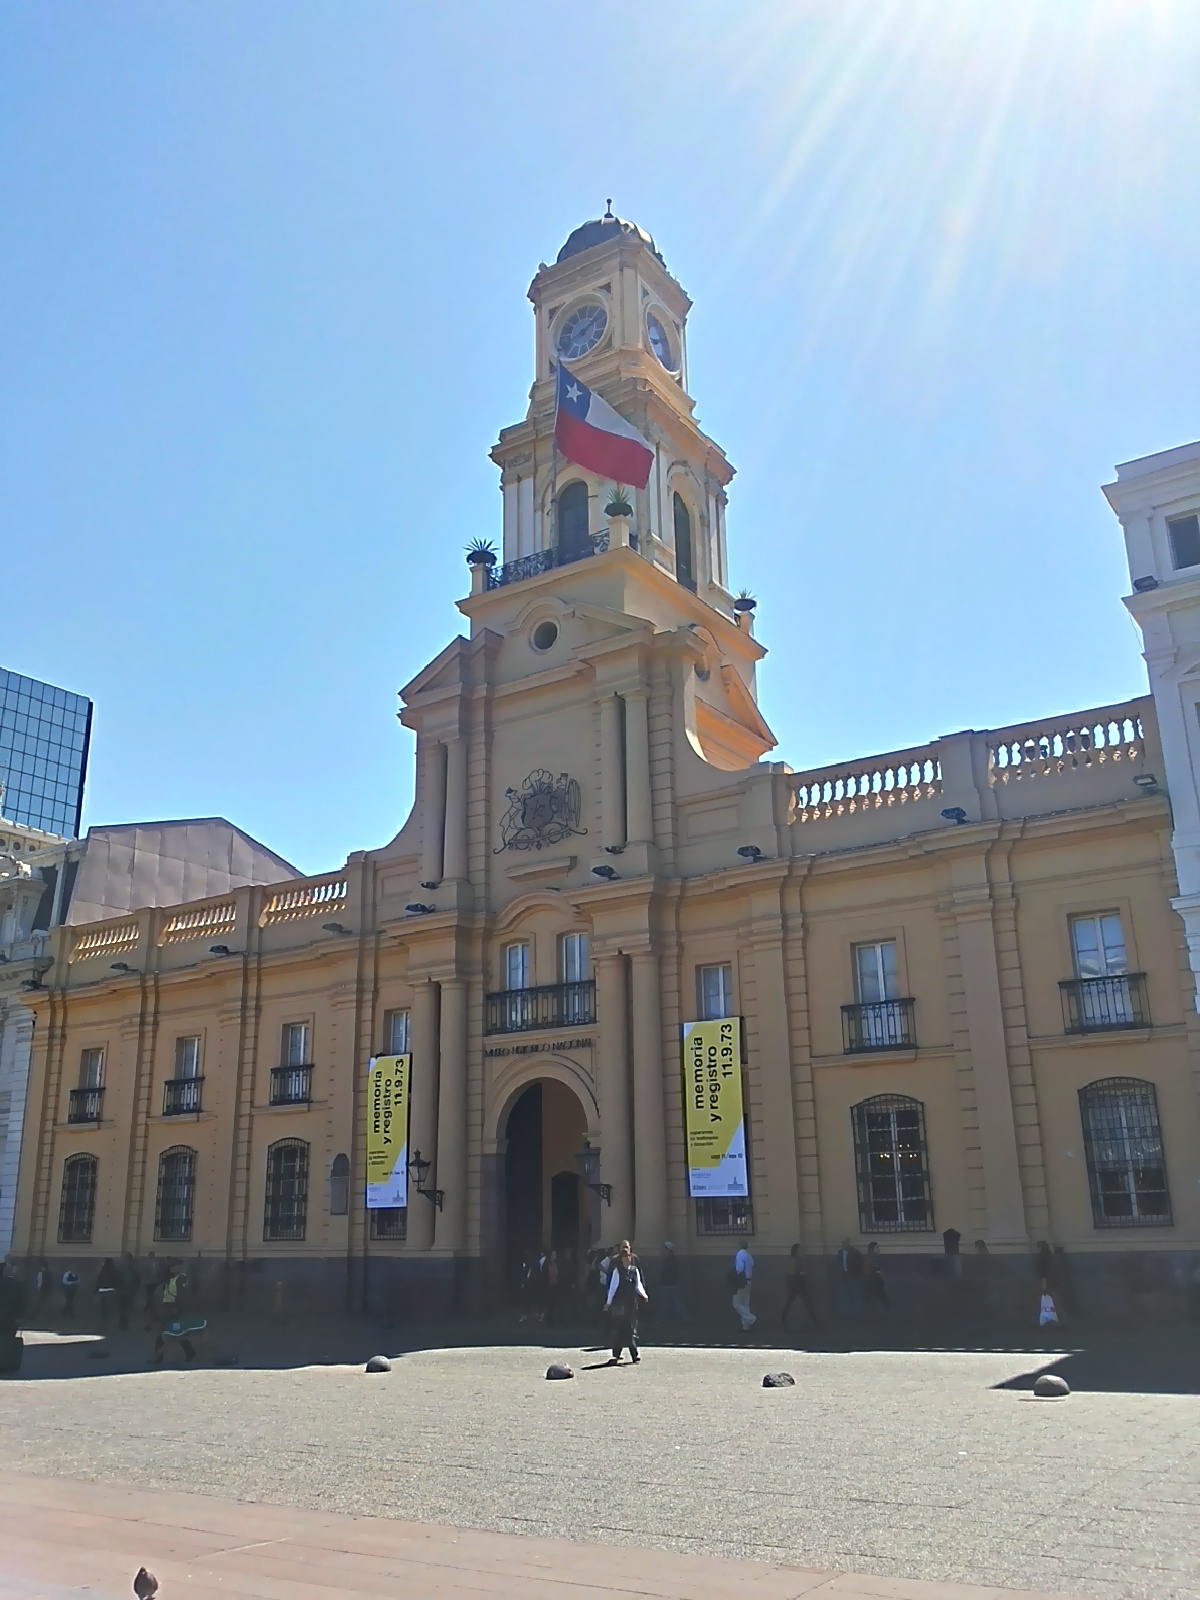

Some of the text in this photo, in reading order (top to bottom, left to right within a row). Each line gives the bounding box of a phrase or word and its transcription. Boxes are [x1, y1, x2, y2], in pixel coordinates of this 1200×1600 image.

[394, 1058, 404, 1107] 11.9.73
[690, 1036, 704, 1109] memoria
[720, 1023, 733, 1079] 11.9.73
[373, 1070, 383, 1134] memoria
[382, 1078, 393, 1145] y registro
[706, 1045, 722, 1123] y registro
